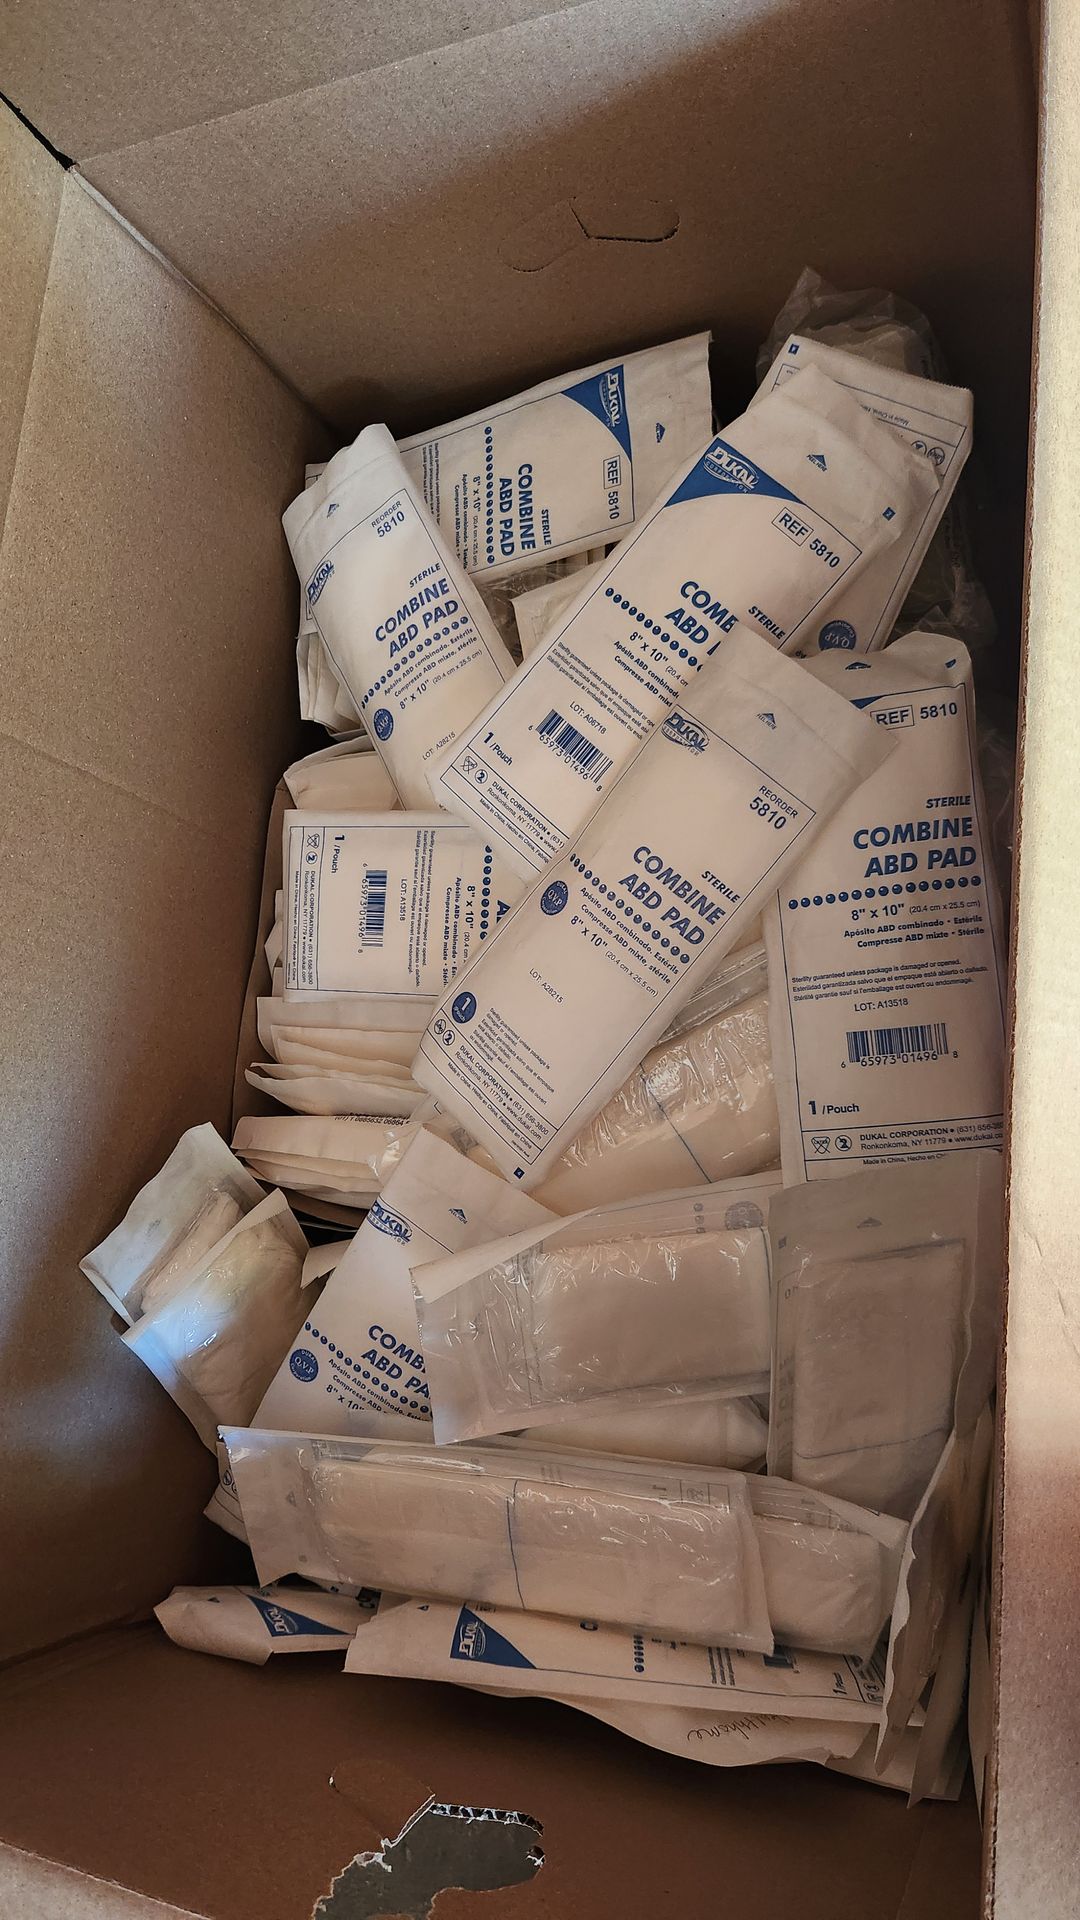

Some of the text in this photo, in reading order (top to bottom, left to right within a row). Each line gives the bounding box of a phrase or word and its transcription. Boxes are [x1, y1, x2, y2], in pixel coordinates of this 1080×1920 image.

[705, 445, 759, 489] DUKAL
[472, 496, 481, 512] 10"
[517, 463, 536, 550] COMBINE
[606, 459, 620, 520] REF 5810
[370, 500, 402, 528] REORDER
[376, 510, 405, 537] 5810
[498, 477, 515, 556] ABD PAD
[540, 508, 552, 546] STERILE
[778, 512, 840, 568] REF 5810
[408, 562, 441, 588] STERILE
[375, 577, 450, 642] COMBINE
[679, 580, 739, 634] COMB
[747, 605, 786, 640] STERILE
[389, 599, 459, 658] ABD PAD
[663, 607, 709, 644] ABD
[401, 665, 414, 678] ABD
[422, 660, 437, 673] ABD
[613, 640, 648, 671] Apósito ABD
[628, 631, 681, 680] 8" x 10" (20.4
[613, 654, 659, 695] Compresse ABD
[399, 696, 408, 710] 8"
[416, 678, 429, 695] 10"
[568, 700, 585, 717] LOT:
[875, 701, 958, 725] REF 5810
[483, 731, 513, 766] 1 /Pouch
[662, 711, 710, 752] DUKAL
[538, 733, 590, 780] 65973 01496
[491, 780, 565, 849] DUKAL CORPORATION (631)
[516, 814, 527, 824] NY
[748, 795, 787, 829] 5810
[758, 784, 798, 819] REORDER
[925, 794, 971, 809] STERILE
[852, 815, 976, 850] COMBINE
[330, 843, 340, 873] /Pouch
[863, 845, 977, 878] ABD PAD
[398, 878, 407, 921] LOT: A13518
[453, 876, 462, 903] Apósito
[466, 885, 476, 898] 8"
[632, 845, 726, 926] COMBINE
[700, 870, 740, 903] STERILE
[302, 908, 308, 918] NY
[307, 892, 315, 938] CORPORATION
[357, 878, 368, 938] 65973 01496
[442, 886, 452, 940] Compresse ABD
[464, 910, 474, 929] 10"
[617, 873, 705, 945] ABD PAD
[850, 907, 865, 921] 8"
[869, 908, 879, 918] x
[881, 902, 904, 916] 10"
[908, 904, 928, 915] (20.4
[947, 900, 965, 909] 25.5
[966, 898, 981, 908] cm)
[450, 920, 459, 959] combinado
[462, 931, 470, 947] (20.4
[579, 886, 679, 975] Apósito ABD Estérils
[580, 903, 671, 984] Compresse ABD mixte, stérile
[843, 918, 945, 938] Apósito ABD combinado
[856, 930, 949, 948] Compresse ABD mixte
[569, 914, 584, 925] 8"
[580, 926, 590, 936] x
[589, 933, 608, 947] 10"
[604, 950, 621, 965] (20.4
[619, 963, 629, 973] cm
[632, 973, 648, 988] 25.5
[645, 985, 659, 998] cm)
[528, 967, 564, 1003] LOT: A28215
[853, 997, 909, 1012] LOT: A13518
[860, 1054, 897, 1067] 65973
[901, 1049, 938, 1063] 01496
[454, 1050, 481, 1083] Ronkonkoma,
[481, 1079, 490, 1089] NY
[505, 1105, 542, 1141] www.dukal.com
[458, 1044, 549, 1136] DUKAL CORPORATION (631) 656-3800
[807, 1100, 860, 1115] 1 /Pouch
[859, 1127, 949, 1141] DUKAL CORPORATION
[860, 1138, 923, 1150] Ronkonkoma, NY
[368, 1324, 426, 1374] COMB
[351, 1377, 366, 1390] ABD
[360, 1348, 431, 1400] ABD PA
[325, 1383, 345, 1403] 8" x
[366, 1399, 382, 1412] ABD
